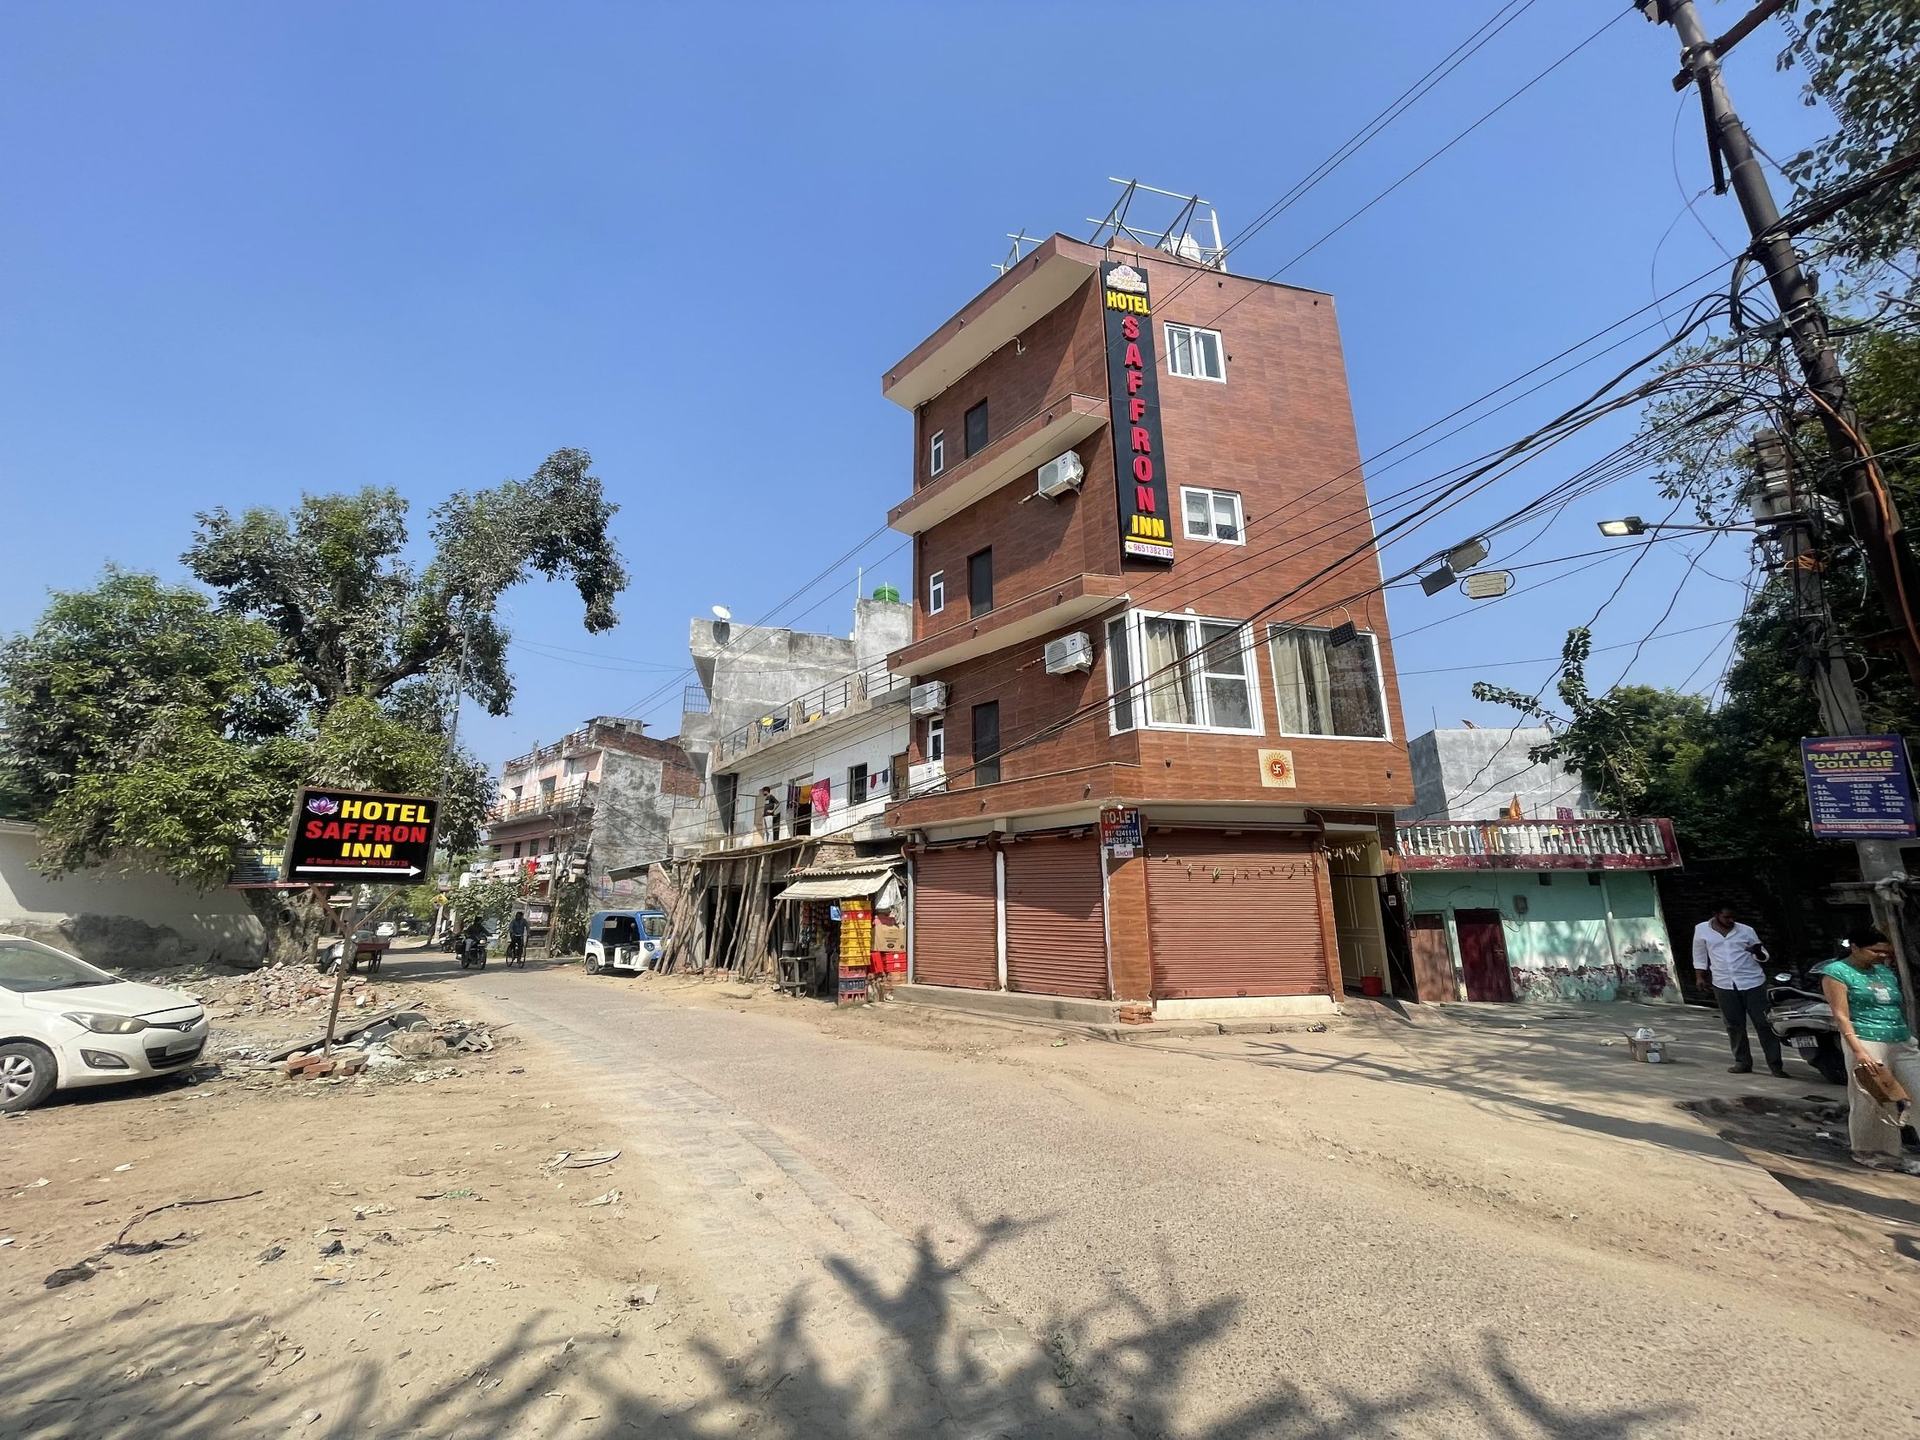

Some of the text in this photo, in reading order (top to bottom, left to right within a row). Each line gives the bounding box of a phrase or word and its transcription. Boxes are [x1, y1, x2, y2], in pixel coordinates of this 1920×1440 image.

[1106, 291, 1151, 315] HOTEL
[1122, 315, 1156, 513] SAFFRON
[1131, 514, 1166, 539] INN
[1807, 751, 1861, 761] RAJAT
[1814, 759, 1894, 769] COLLEGE
[340, 799, 431, 824] HOTEL
[305, 820, 427, 843] SAFFRON
[341, 842, 393, 859] INN
